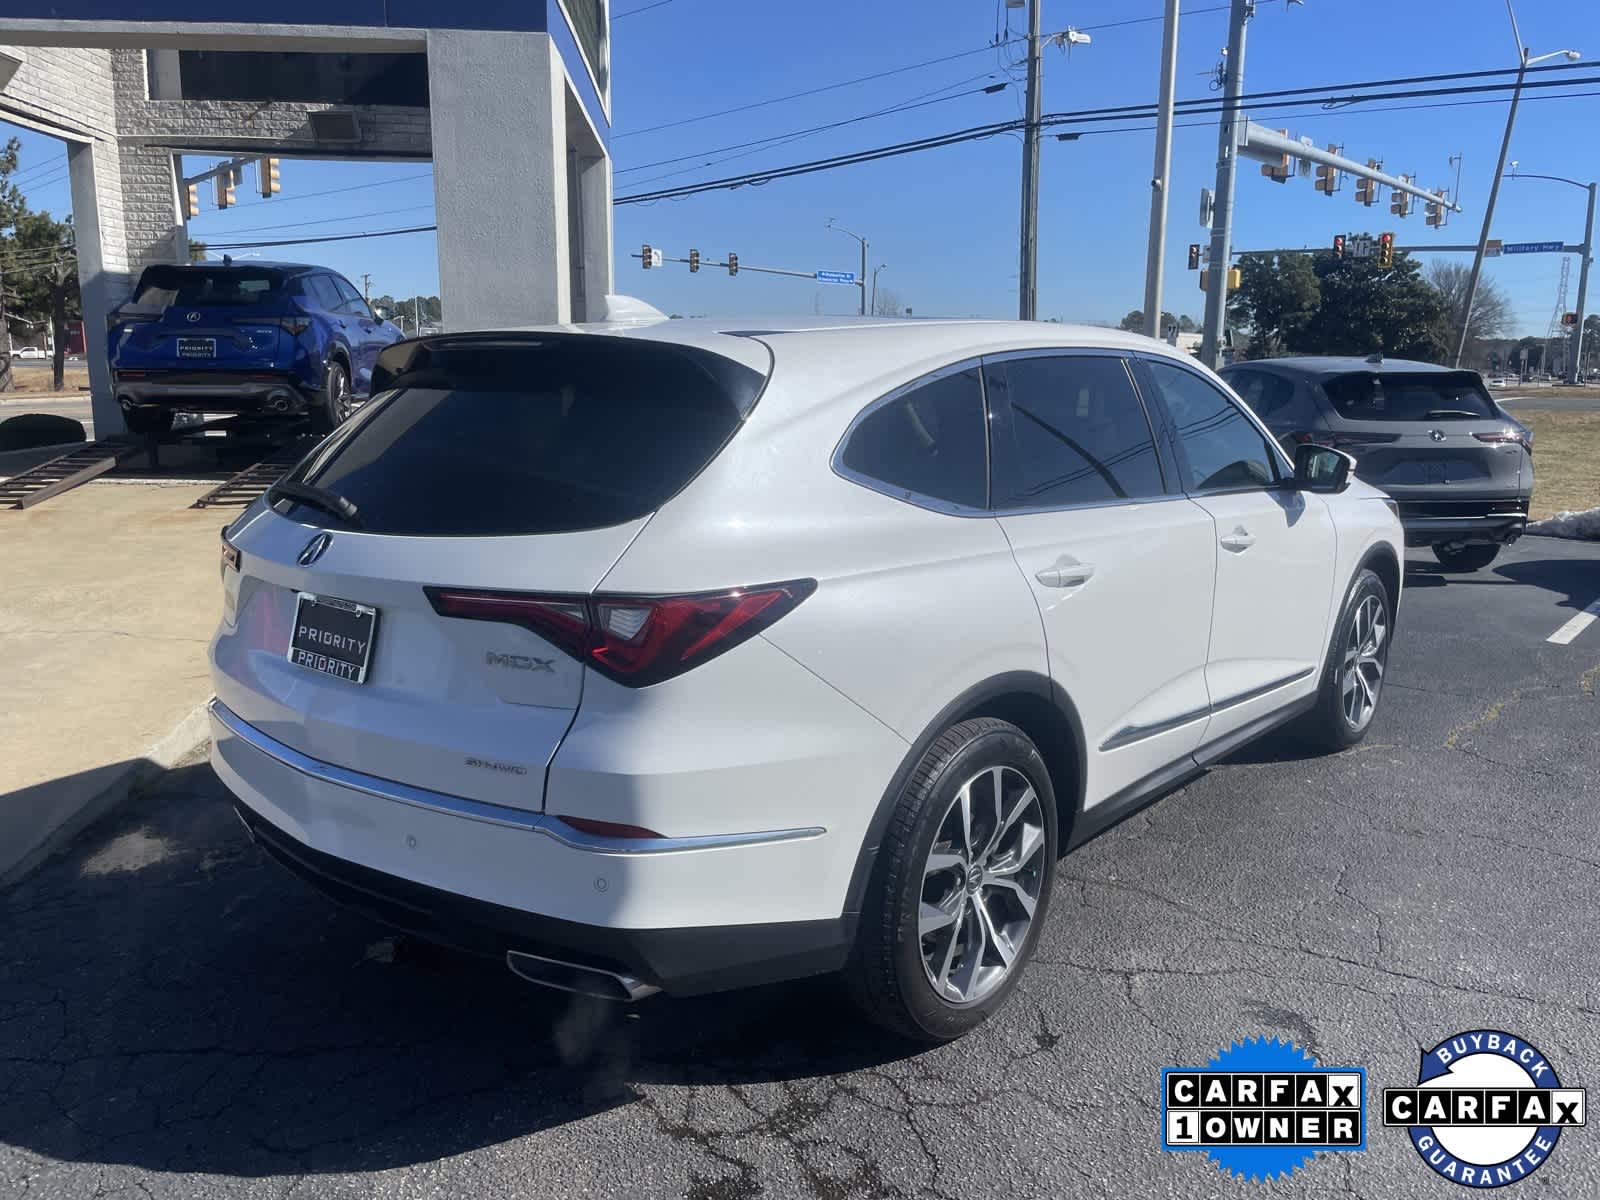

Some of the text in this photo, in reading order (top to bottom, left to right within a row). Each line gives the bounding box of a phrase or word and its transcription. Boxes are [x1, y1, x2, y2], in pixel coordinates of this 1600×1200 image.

[299, 625, 366, 655] PRIORITY
[297, 652, 357, 679] PRIORITY
[486, 650, 556, 673] MDX
